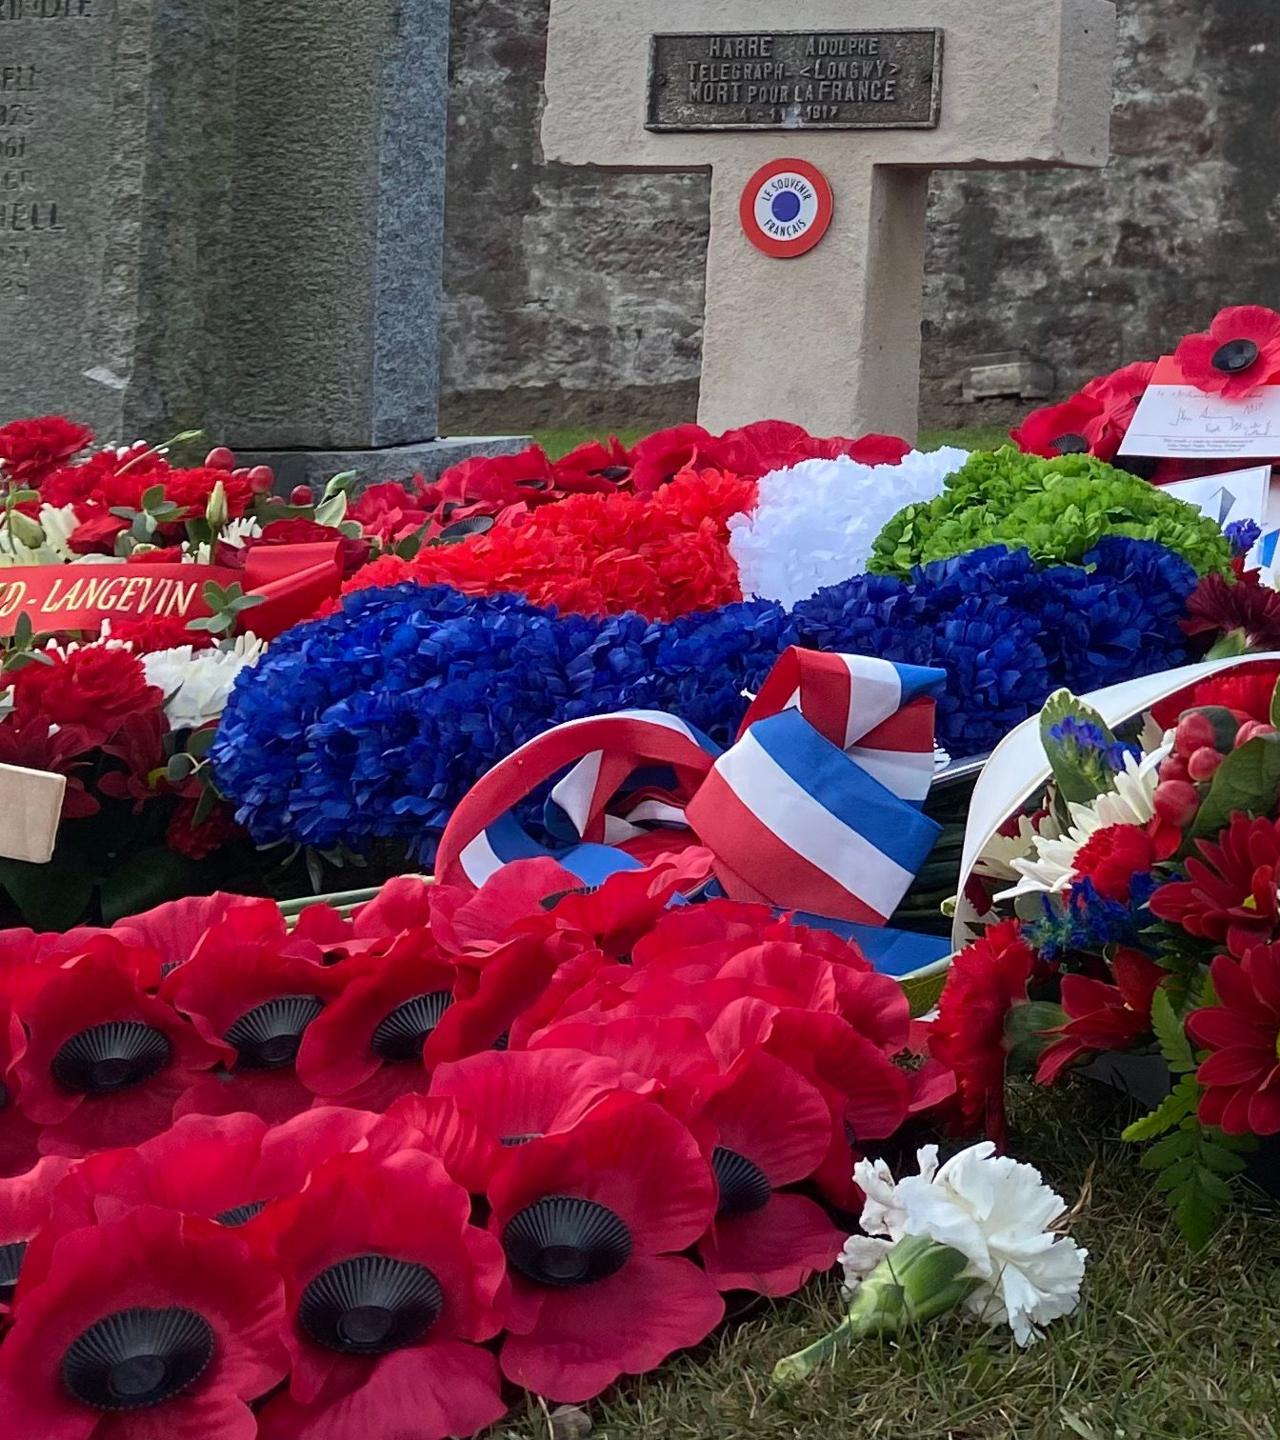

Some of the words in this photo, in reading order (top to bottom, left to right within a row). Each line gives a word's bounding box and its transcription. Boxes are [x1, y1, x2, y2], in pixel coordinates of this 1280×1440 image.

[687, 80, 743, 105] MORT
[749, 84, 788, 104] POUR
[794, 83, 814, 103] LA
[818, 78, 897, 103] FRANCE
[761, 189, 774, 202] LE
[770, 177, 813, 201] SOUVENIR
[763, 218, 807, 238] FRANÇAIS
[41, 576, 198, 618] LANGEVIN
